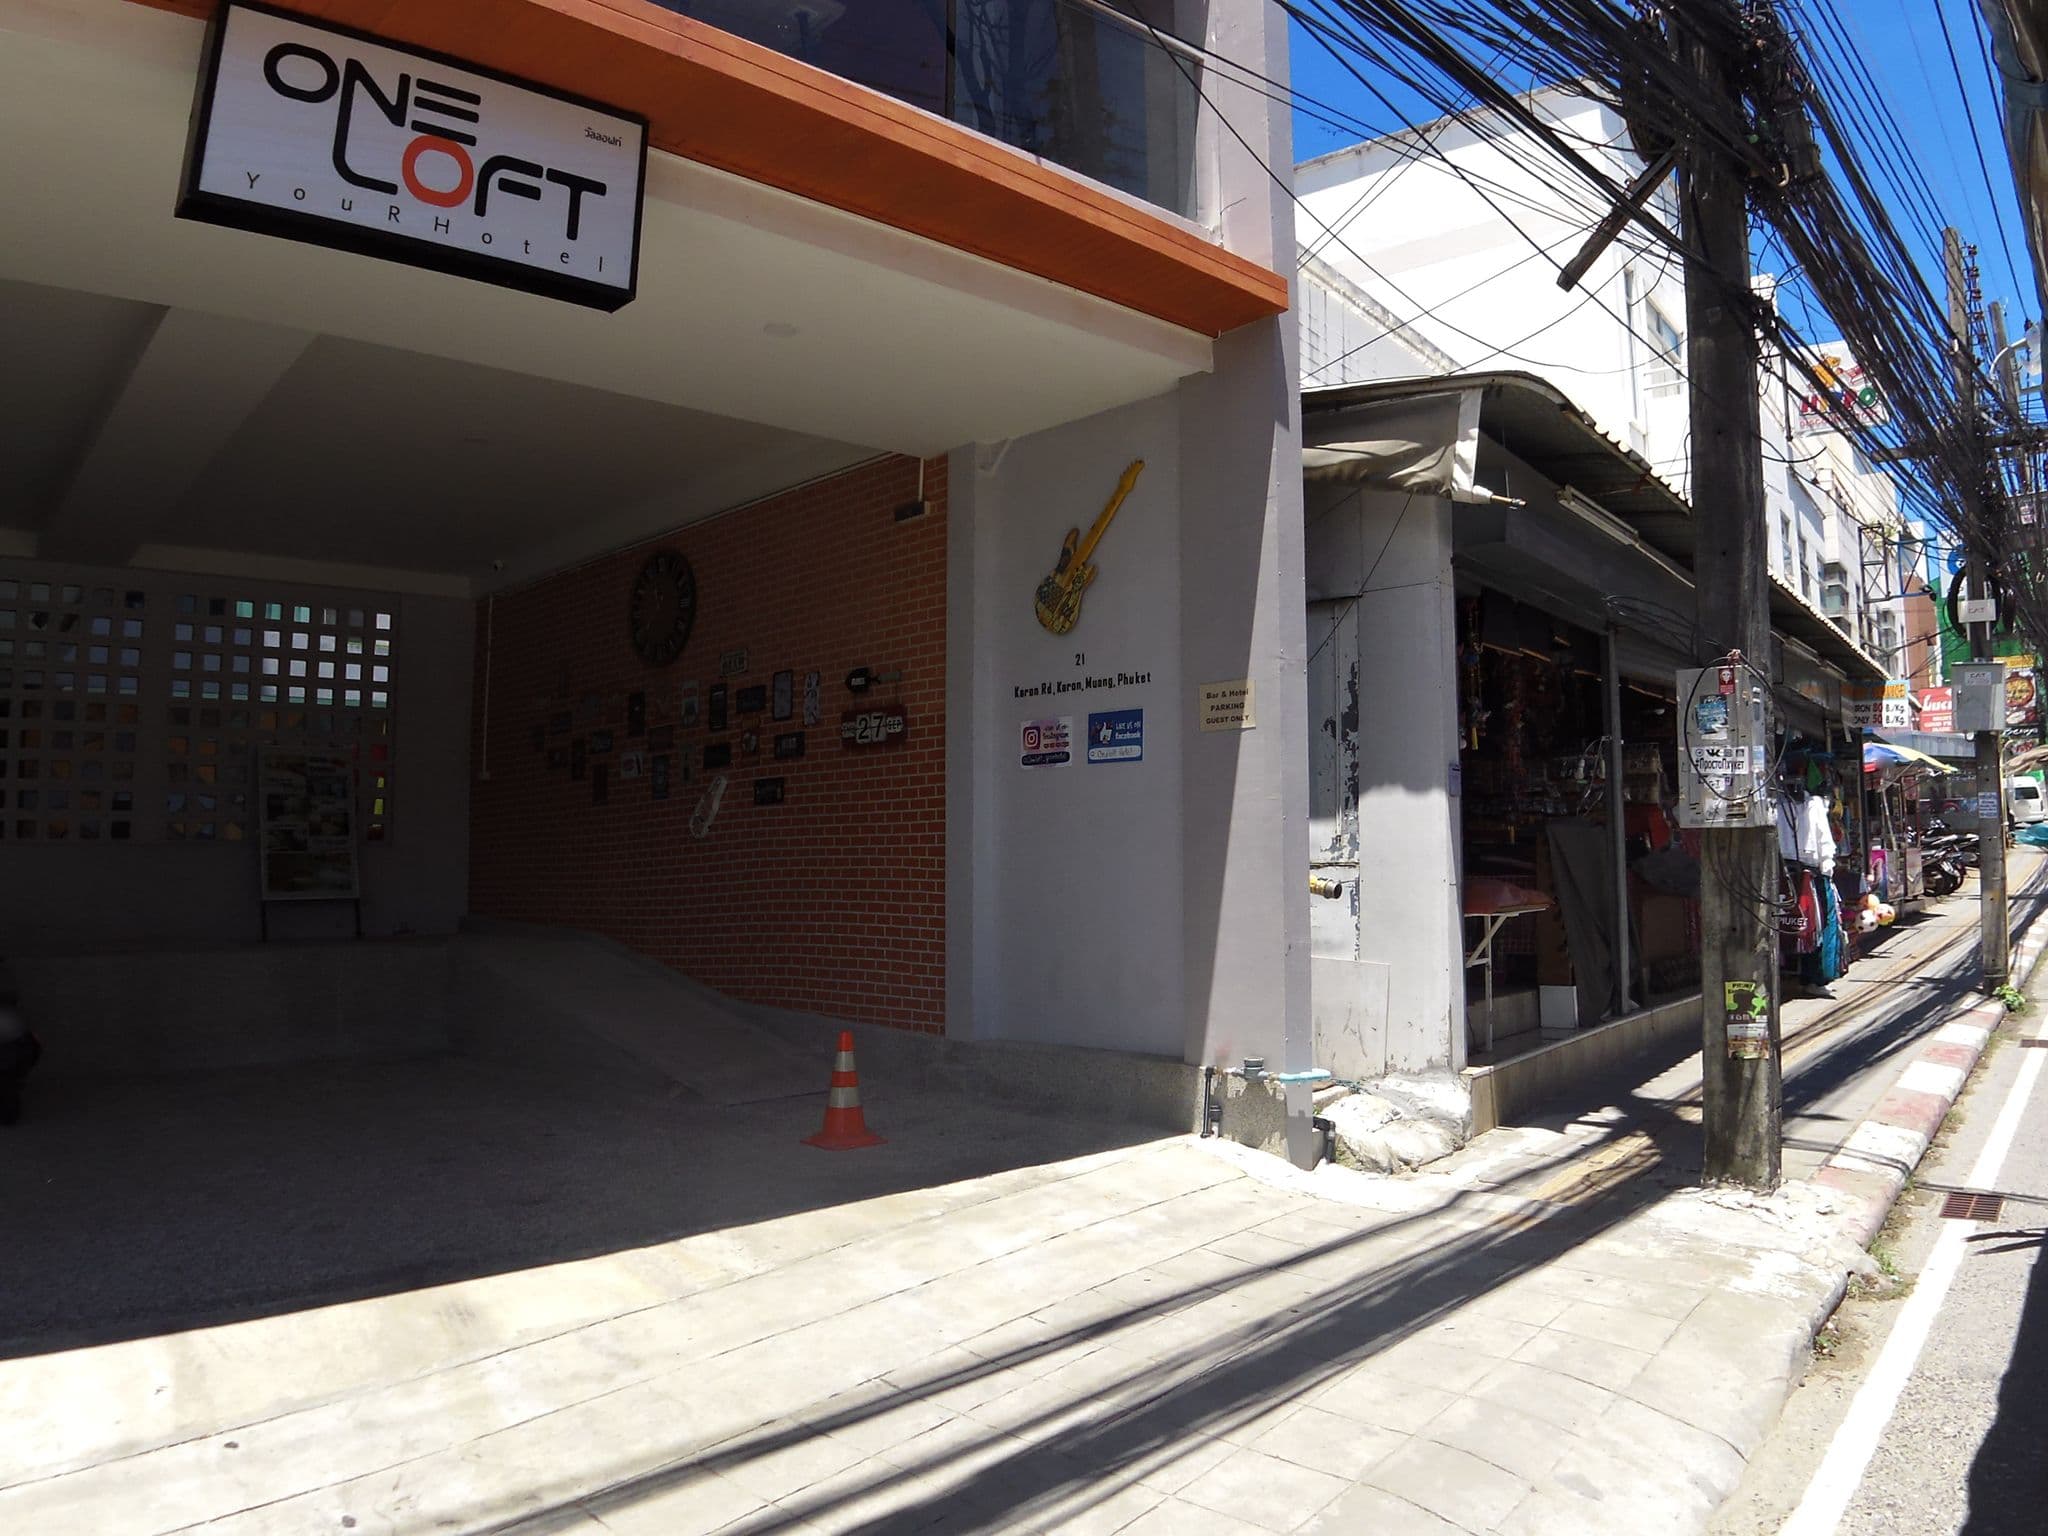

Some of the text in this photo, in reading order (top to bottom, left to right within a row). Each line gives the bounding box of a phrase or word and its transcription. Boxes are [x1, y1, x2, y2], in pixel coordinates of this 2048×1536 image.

[263, 42, 481, 147] ONE
[332, 133, 608, 241] LOFT
[1075, 653, 1085, 666] 21
[1117, 672, 1151, 686] Phuket
[1206, 691, 1219, 699] Bar
[1229, 688, 1249, 697] Hotel
[1210, 702, 1245, 712] PARKING
[1206, 714, 1250, 725] GUEST ONLY
[858, 715, 884, 739] 27
